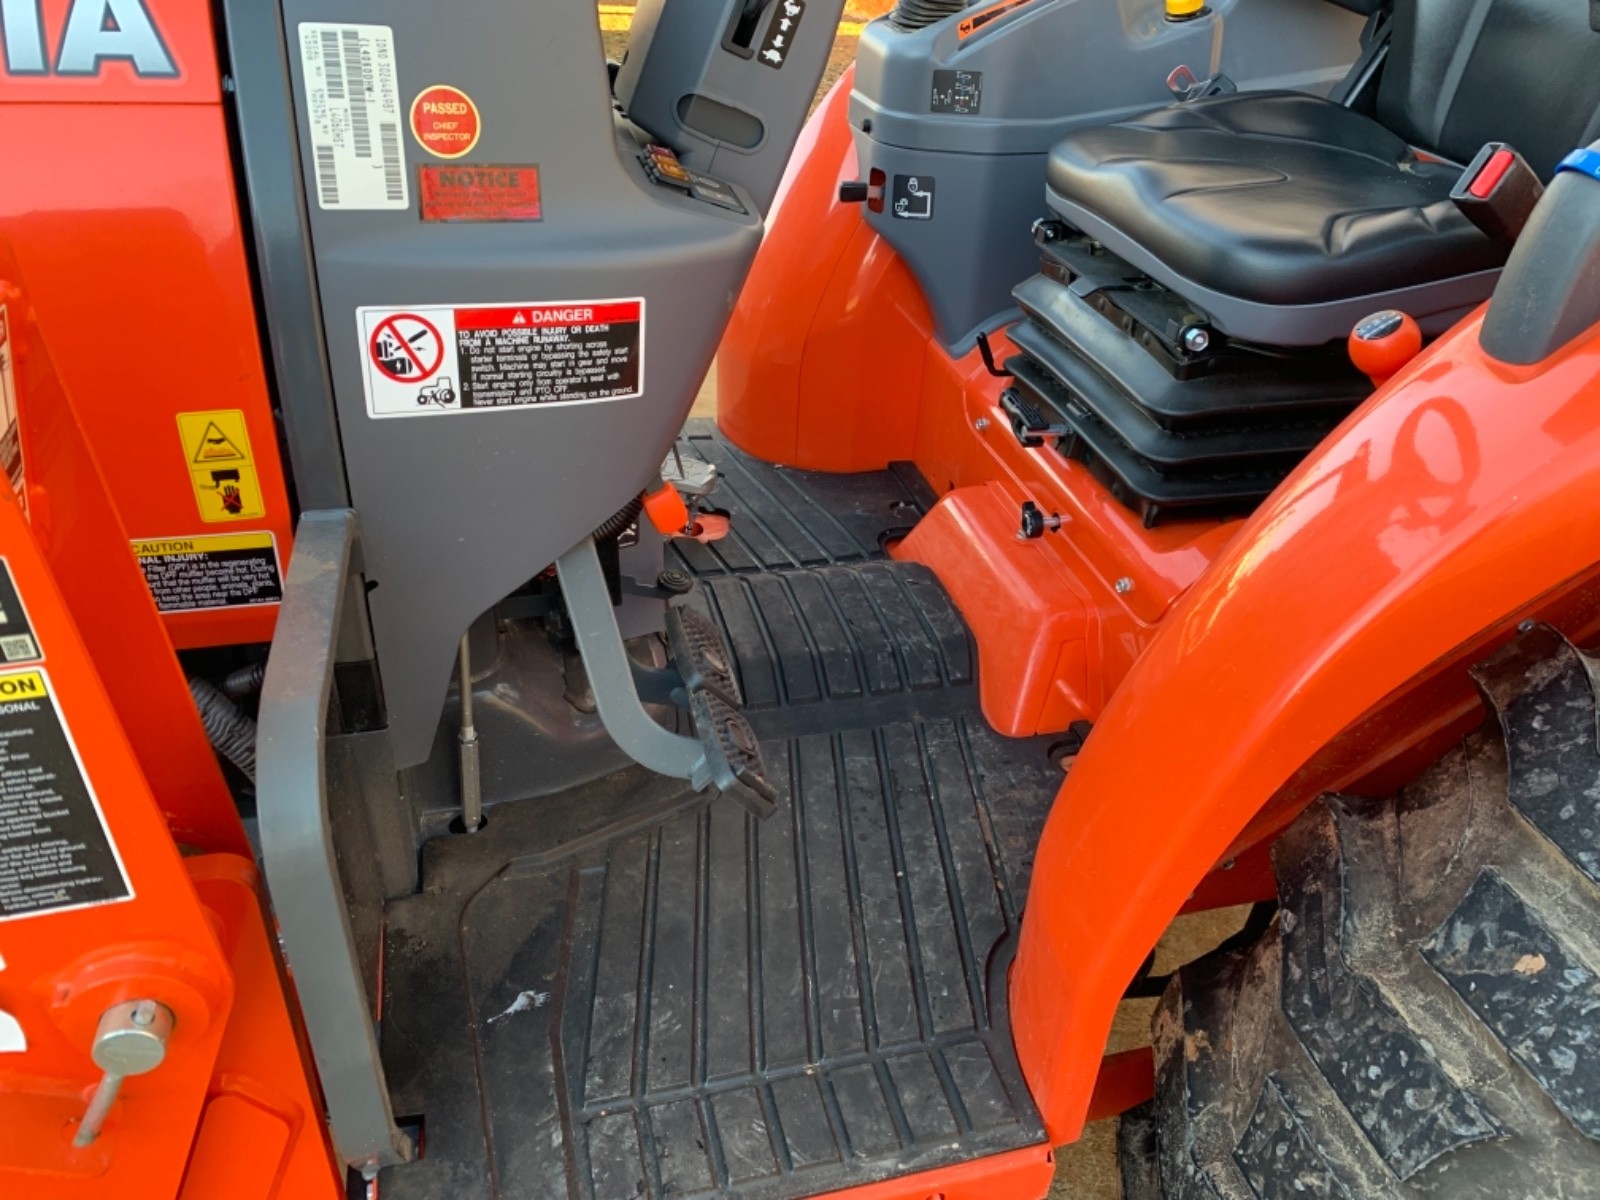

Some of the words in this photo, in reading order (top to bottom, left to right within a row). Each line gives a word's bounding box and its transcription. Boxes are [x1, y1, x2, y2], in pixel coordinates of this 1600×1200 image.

[423, 102, 467, 114] PASSED
[423, 132, 471, 140] INSPECTOR
[439, 171, 519, 188] NOTICE
[532, 309, 593, 323] DANGER
[459, 331, 470, 339] TO
[475, 330, 498, 338] AVOID
[502, 328, 537, 337] POSSIBLE
[541, 327, 566, 336] INJURY
[571, 326, 582, 334] OR
[586, 325, 609, 333] DEATH
[459, 339, 481, 347] FROM
[495, 337, 529, 345] MACHINE
[533, 335, 570, 343] RUNAWAY.
[484, 346, 495, 354] not
[499, 345, 515, 353] start
[518, 345, 541, 354] engine
[544, 344, 553, 352] by
[471, 355, 493, 363] starter
[500, 362, 529, 371] Machine
[472, 382, 489, 390] Start
[492, 381, 516, 390] engine
[519, 380, 533, 388] only
[535, 386, 550, 394] PTO
[497, 396, 511, 404] start
[514, 395, 537, 404] engine
[612, 386, 633, 396] ground.
